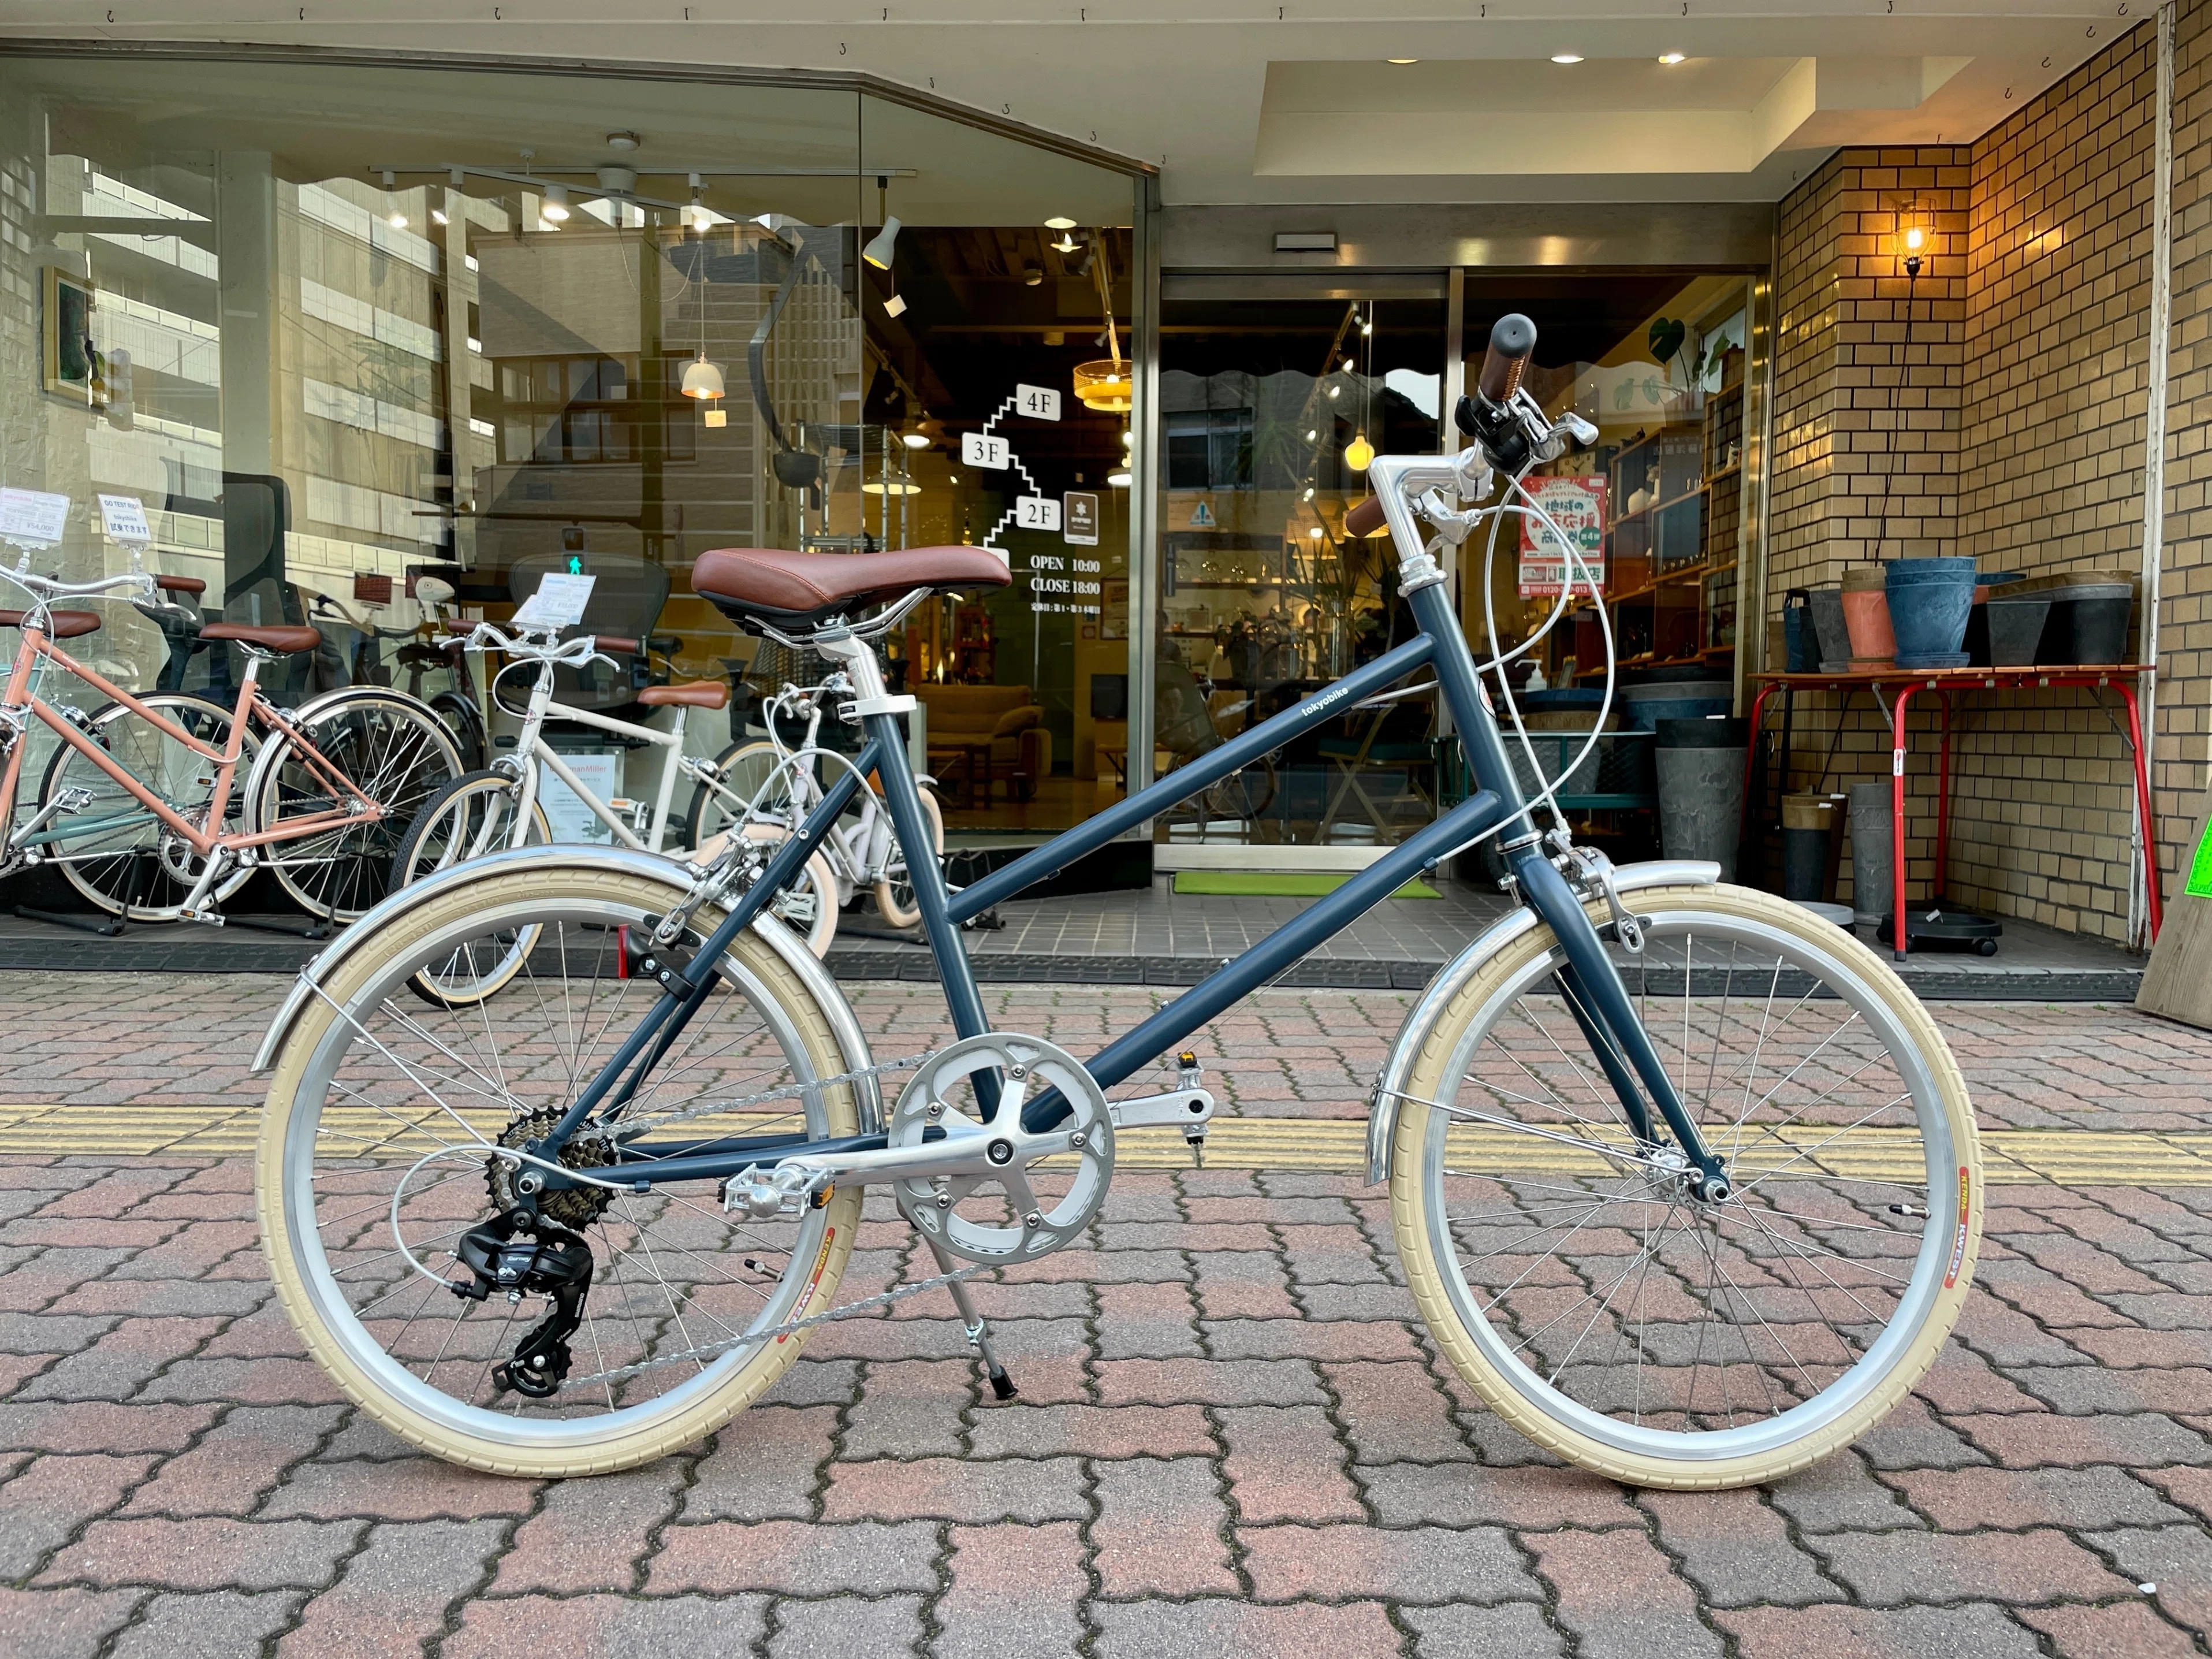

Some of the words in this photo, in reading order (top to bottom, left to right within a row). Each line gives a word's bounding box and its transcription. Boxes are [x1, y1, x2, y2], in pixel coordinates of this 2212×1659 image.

[1027, 393, 1051, 413] 4F
[974, 441, 999, 462] 3F
[1027, 504, 1051, 524] 2F
[1545, 499, 1584, 512] 地域の
[27, 522, 54, 532] ¥54,000
[110, 522, 147, 534] 試乗できます
[1541, 531, 1578, 544] 商券
[1030, 555, 1064, 571] OPEN
[1073, 559, 1100, 573] 10:00
[1030, 578, 1070, 594] CLOSE
[1073, 581, 1100, 595] 18:00
[1543, 586, 1587, 594] 0120--013
[1301, 687, 1349, 716] tokyobike
[566, 765, 607, 773] manMiller
[817, 1236, 832, 1270] KENDA
[1949, 1223, 1967, 1279] KWEST
